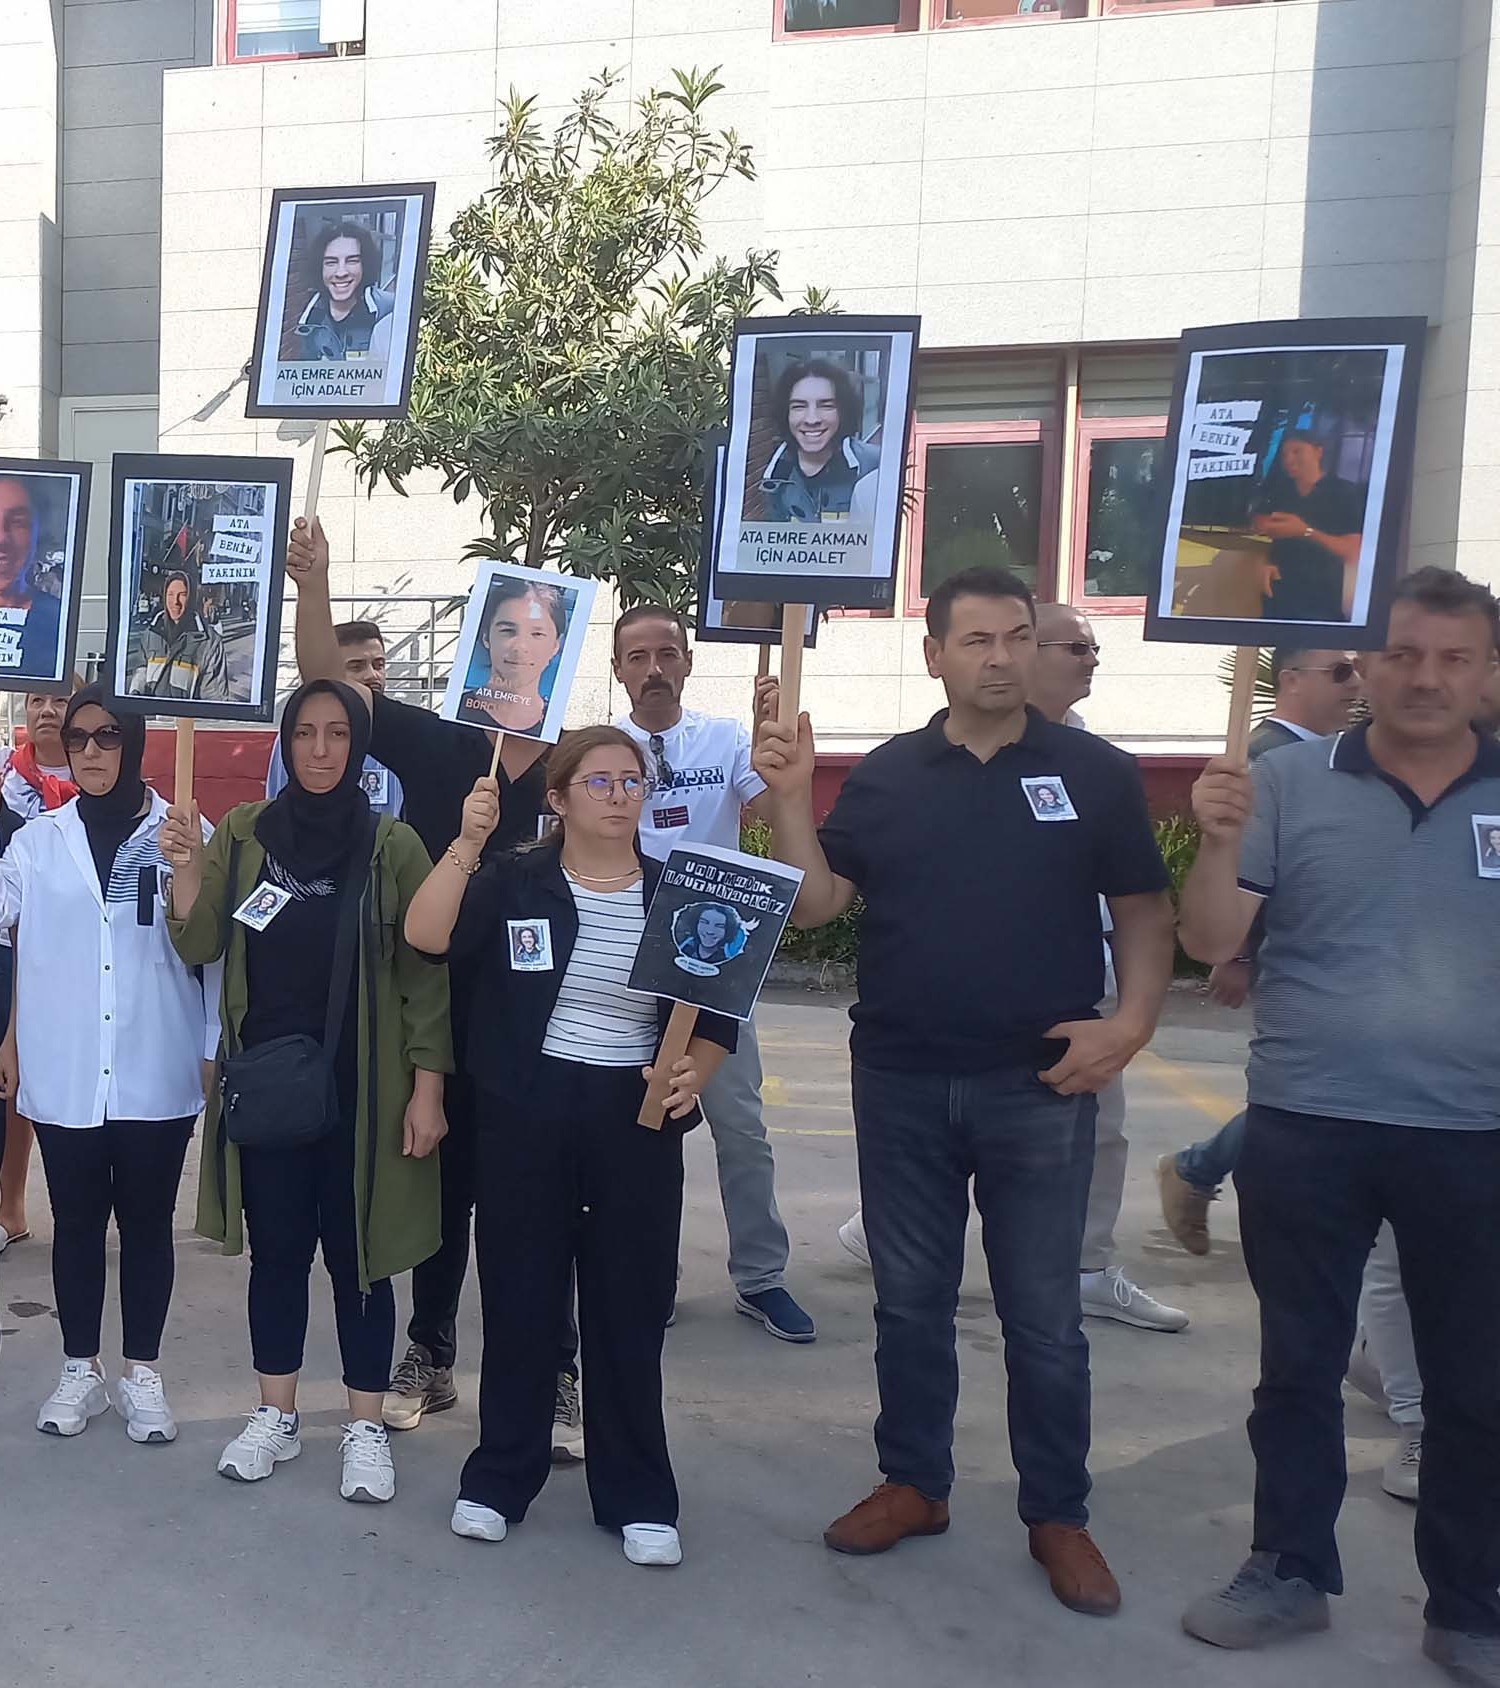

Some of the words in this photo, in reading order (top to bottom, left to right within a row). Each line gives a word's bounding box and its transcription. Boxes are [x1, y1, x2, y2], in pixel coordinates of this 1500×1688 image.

[277, 368, 298, 380] ATA
[302, 368, 335, 380] EMRE
[337, 368, 383, 380] AKMAN
[291, 382, 315, 399] İÇİN
[317, 384, 365, 396] ADALET
[1209, 408, 1233, 420] ATA
[1200, 431, 1240, 447] BENİM
[1193, 459, 1251, 474] YAKINIM
[229, 518, 250, 529] ATA
[739, 531, 764, 544] ATA
[767, 531, 808, 545] EMRE
[810, 532, 868, 546] AKMAN
[219, 539, 253, 555] BENİM
[756, 547, 783, 565] İÇİN
[786, 550, 847, 564] ADALET
[208, 567, 256, 578] YAKINIM
[476, 687, 493, 698] ATA
